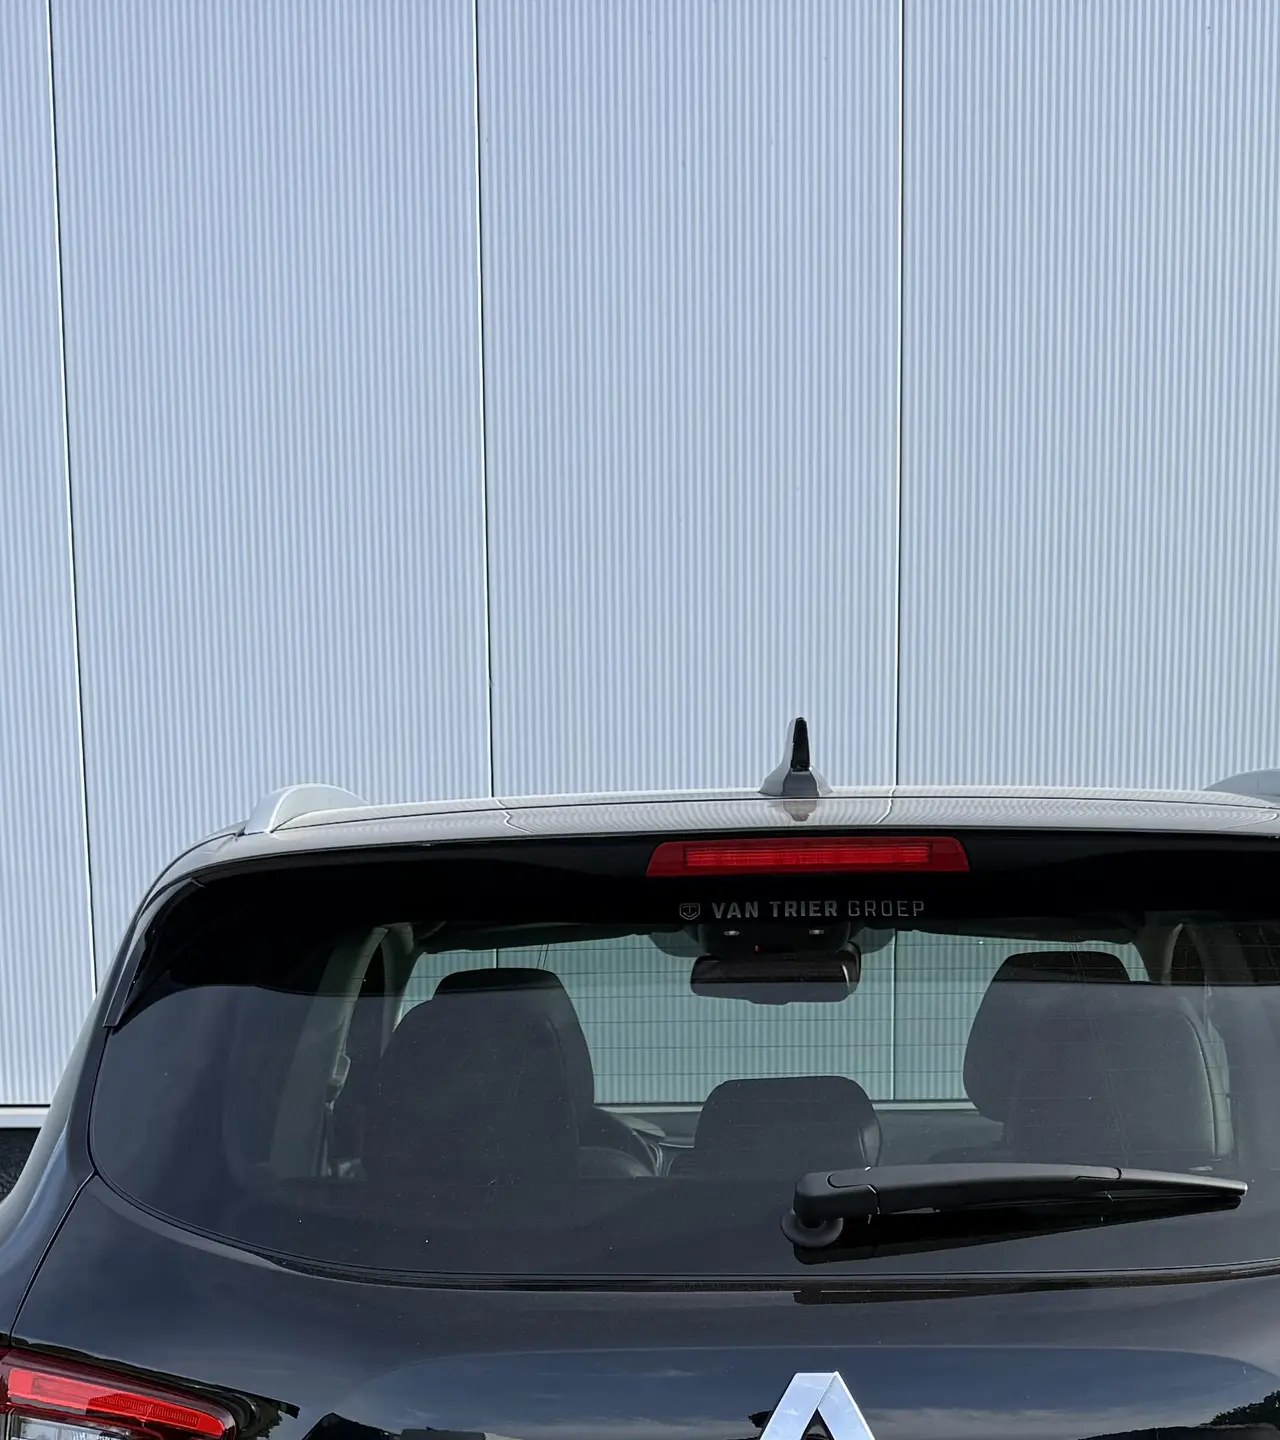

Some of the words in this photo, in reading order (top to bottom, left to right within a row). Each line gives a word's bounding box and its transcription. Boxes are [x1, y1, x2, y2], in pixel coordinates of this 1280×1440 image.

[711, 900, 759, 919] VAN
[769, 900, 838, 918] TRIER
[848, 900, 925, 917] GROEP
